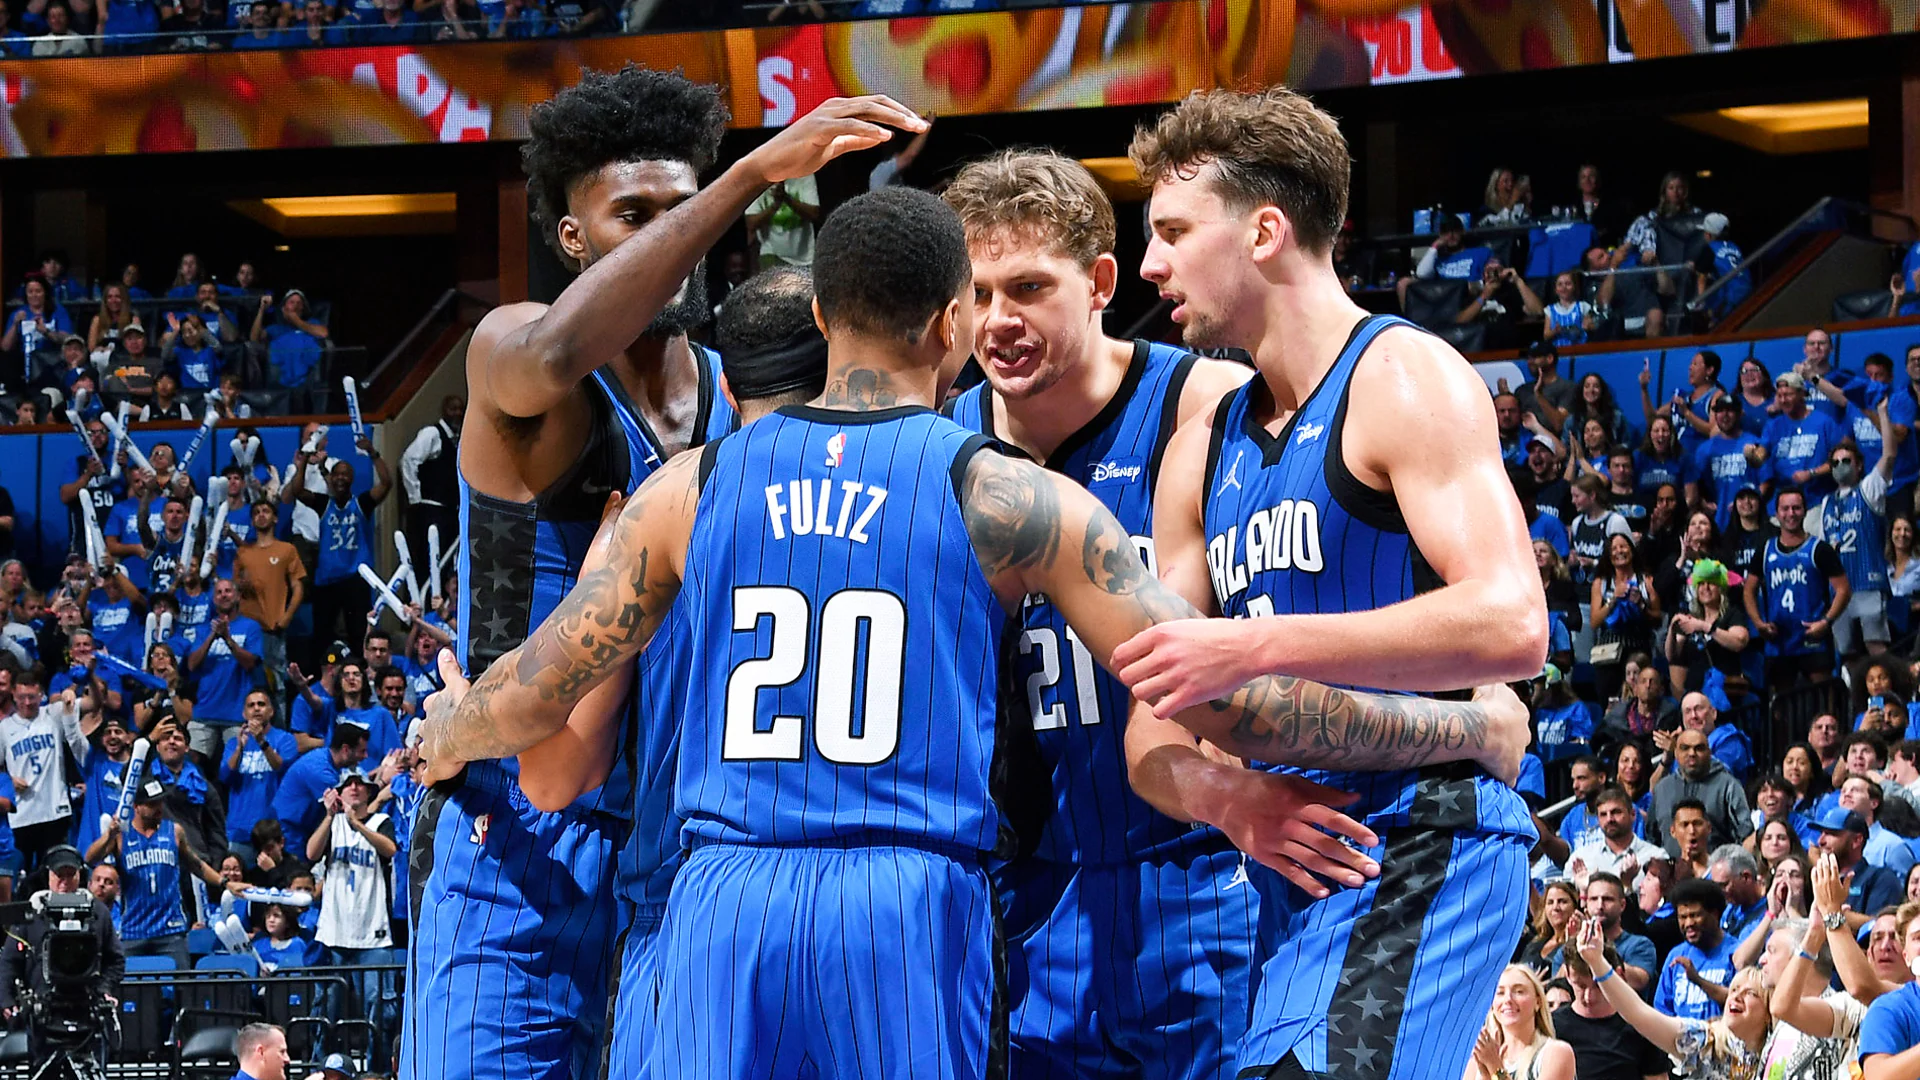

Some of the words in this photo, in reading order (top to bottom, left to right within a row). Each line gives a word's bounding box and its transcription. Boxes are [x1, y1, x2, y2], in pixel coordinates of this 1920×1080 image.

[93, 490, 114, 507] 50
[765, 478, 888, 544] FULTZ
[330, 527, 358, 550] 32
[1781, 588, 1795, 613] 4
[721, 584, 907, 766] 20
[1018, 624, 1102, 731] 21
[11, 732, 56, 761] MAGIC
[30, 756, 42, 776] 5
[119, 758, 144, 821] GEICO
[126, 849, 176, 870] ORLANDO
[150, 873, 157, 894] 1
